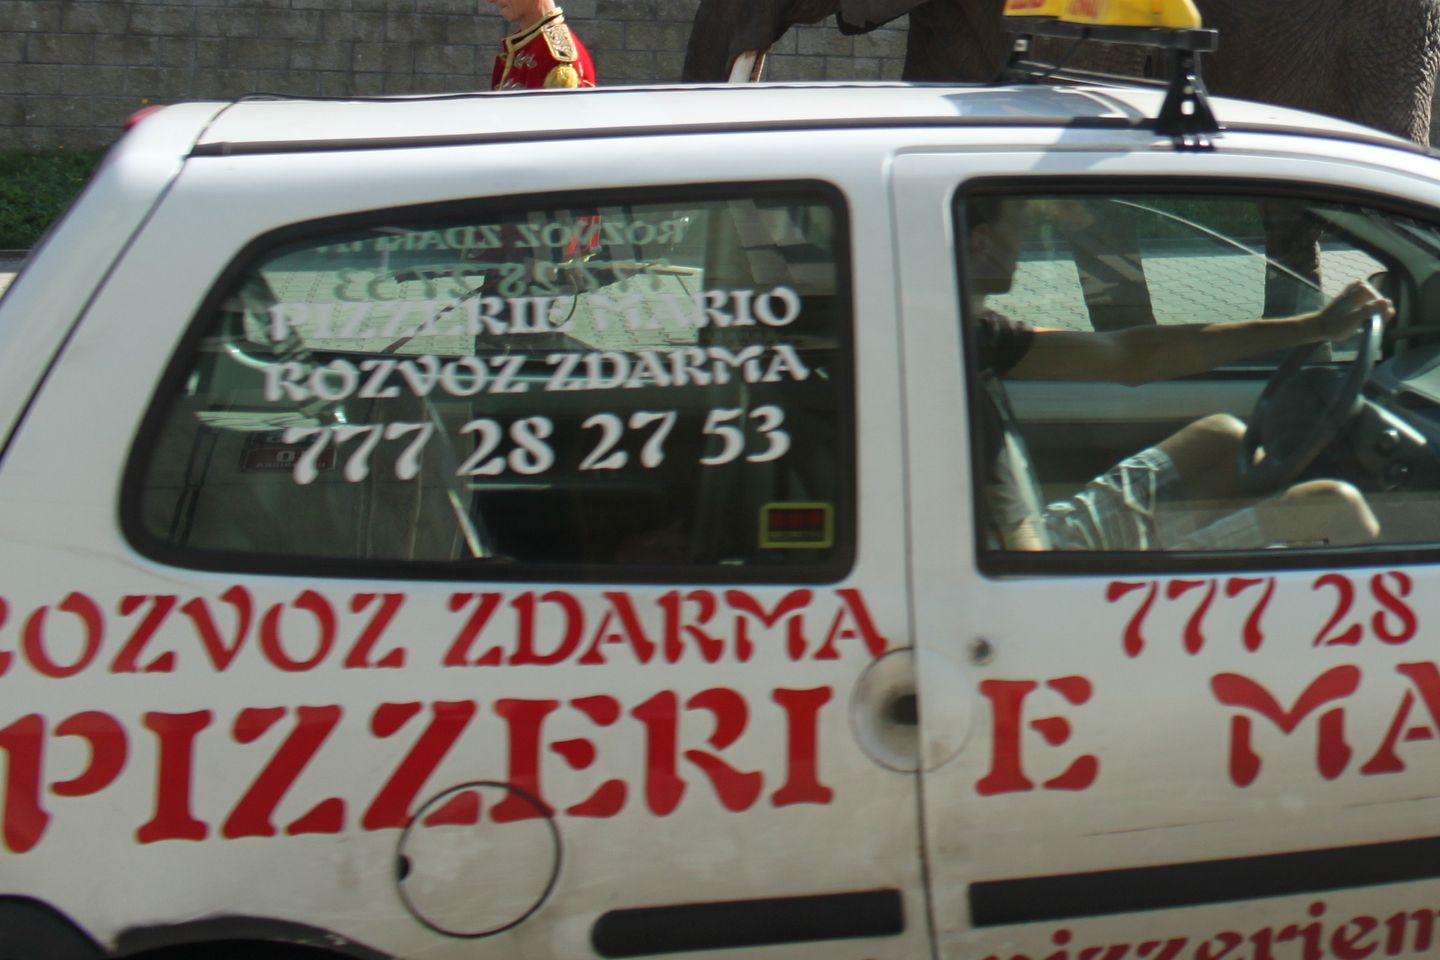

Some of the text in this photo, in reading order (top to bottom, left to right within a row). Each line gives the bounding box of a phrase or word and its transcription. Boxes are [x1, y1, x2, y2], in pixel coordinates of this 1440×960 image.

[268, 286, 801, 342] PIZZERIE MARIO
[263, 343, 810, 402] ROZVOZ ZDARMA
[282, 422, 434, 484] 777
[456, 414, 556, 476] 28
[578, 411, 678, 471] 27
[700, 405, 792, 465] 53
[0, 584, 889, 678] OZVOZ ZDARMA
[1107, 580, 1276, 658] 777
[1312, 571, 1418, 646] 28
